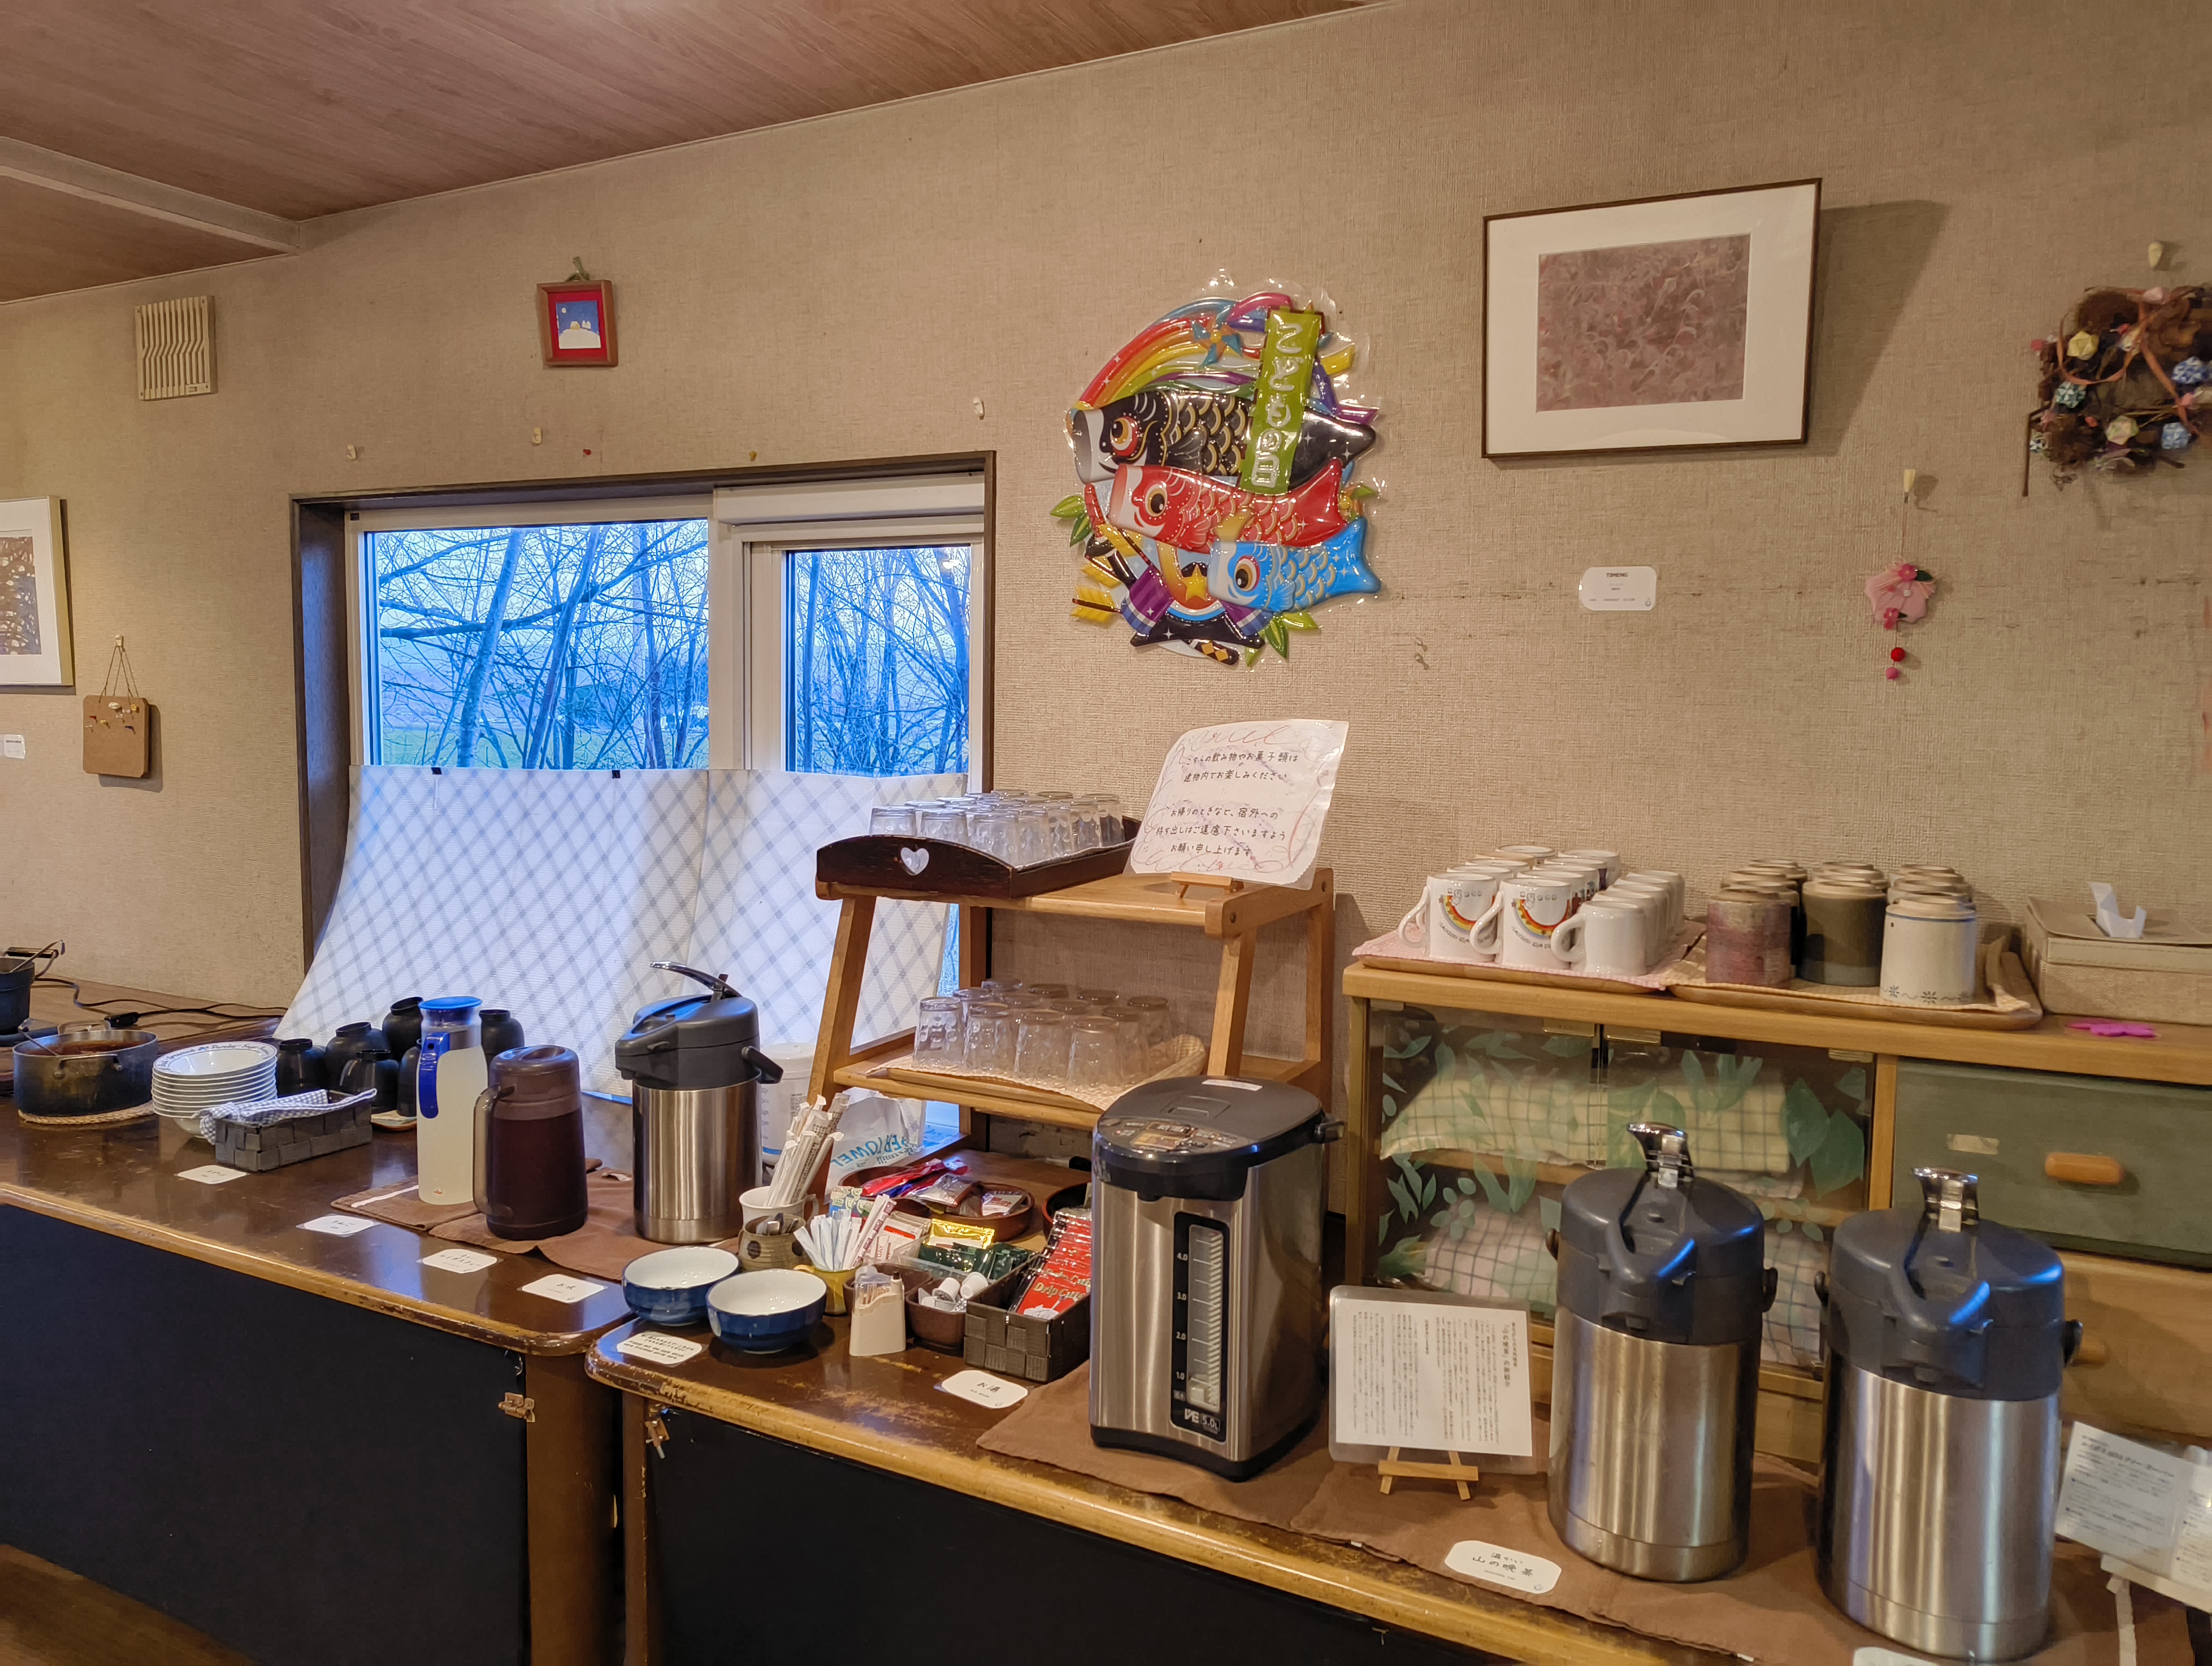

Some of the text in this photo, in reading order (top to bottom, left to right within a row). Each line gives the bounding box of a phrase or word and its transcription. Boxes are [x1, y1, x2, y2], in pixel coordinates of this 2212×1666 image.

[1250, 322, 1303, 488] こどもの日
[1177, 1252, 1188, 1261] 4.0
[1033, 1282, 1059, 1298] Drip
[1176, 1331, 1186, 1340] 2.0
[1176, 1371, 1185, 1380] 1.0
